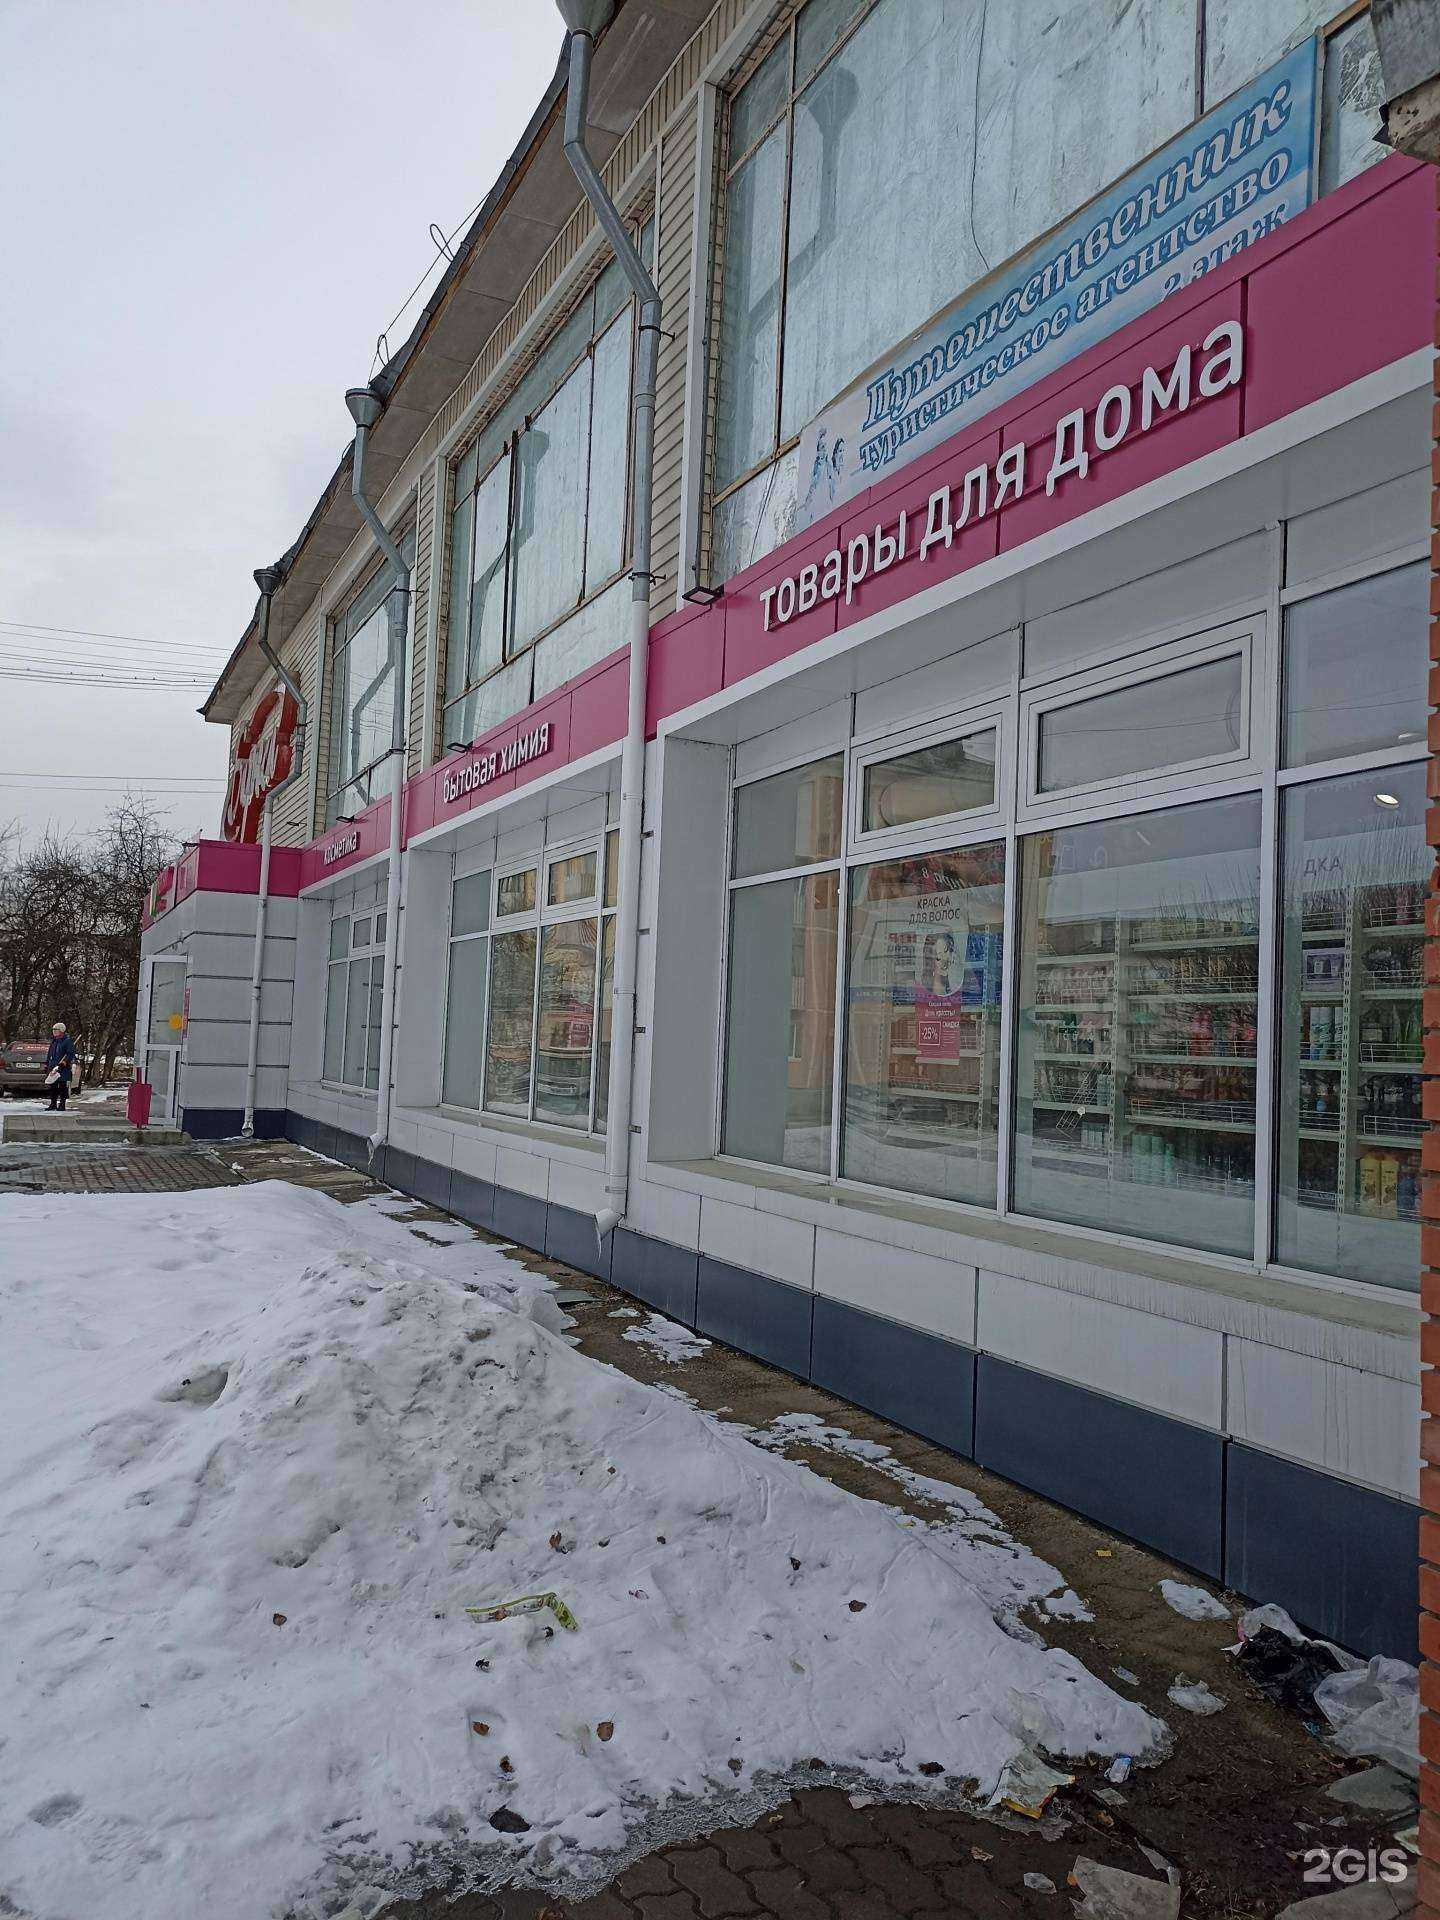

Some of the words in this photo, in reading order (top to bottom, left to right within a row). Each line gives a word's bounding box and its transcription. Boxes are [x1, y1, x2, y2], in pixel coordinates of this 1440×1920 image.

[861, 79, 1292, 433] Путешественник
[1161, 272, 1182, 300] 2
[1192, 203, 1287, 281] этаж
[859, 302, 1071, 471] туристическое
[1075, 147, 1293, 324] агентство
[760, 510, 907, 632] товары
[920, 441, 1025, 562] для
[1046, 320, 1243, 497] дома
[443, 752, 497, 803] бытовая
[500, 722, 549, 774] химия
[909, 912, 927, 925] ДЛЯ
[929, 908, 960, 921] ВОЛОС
[917, 895, 951, 910] КРАСКА
